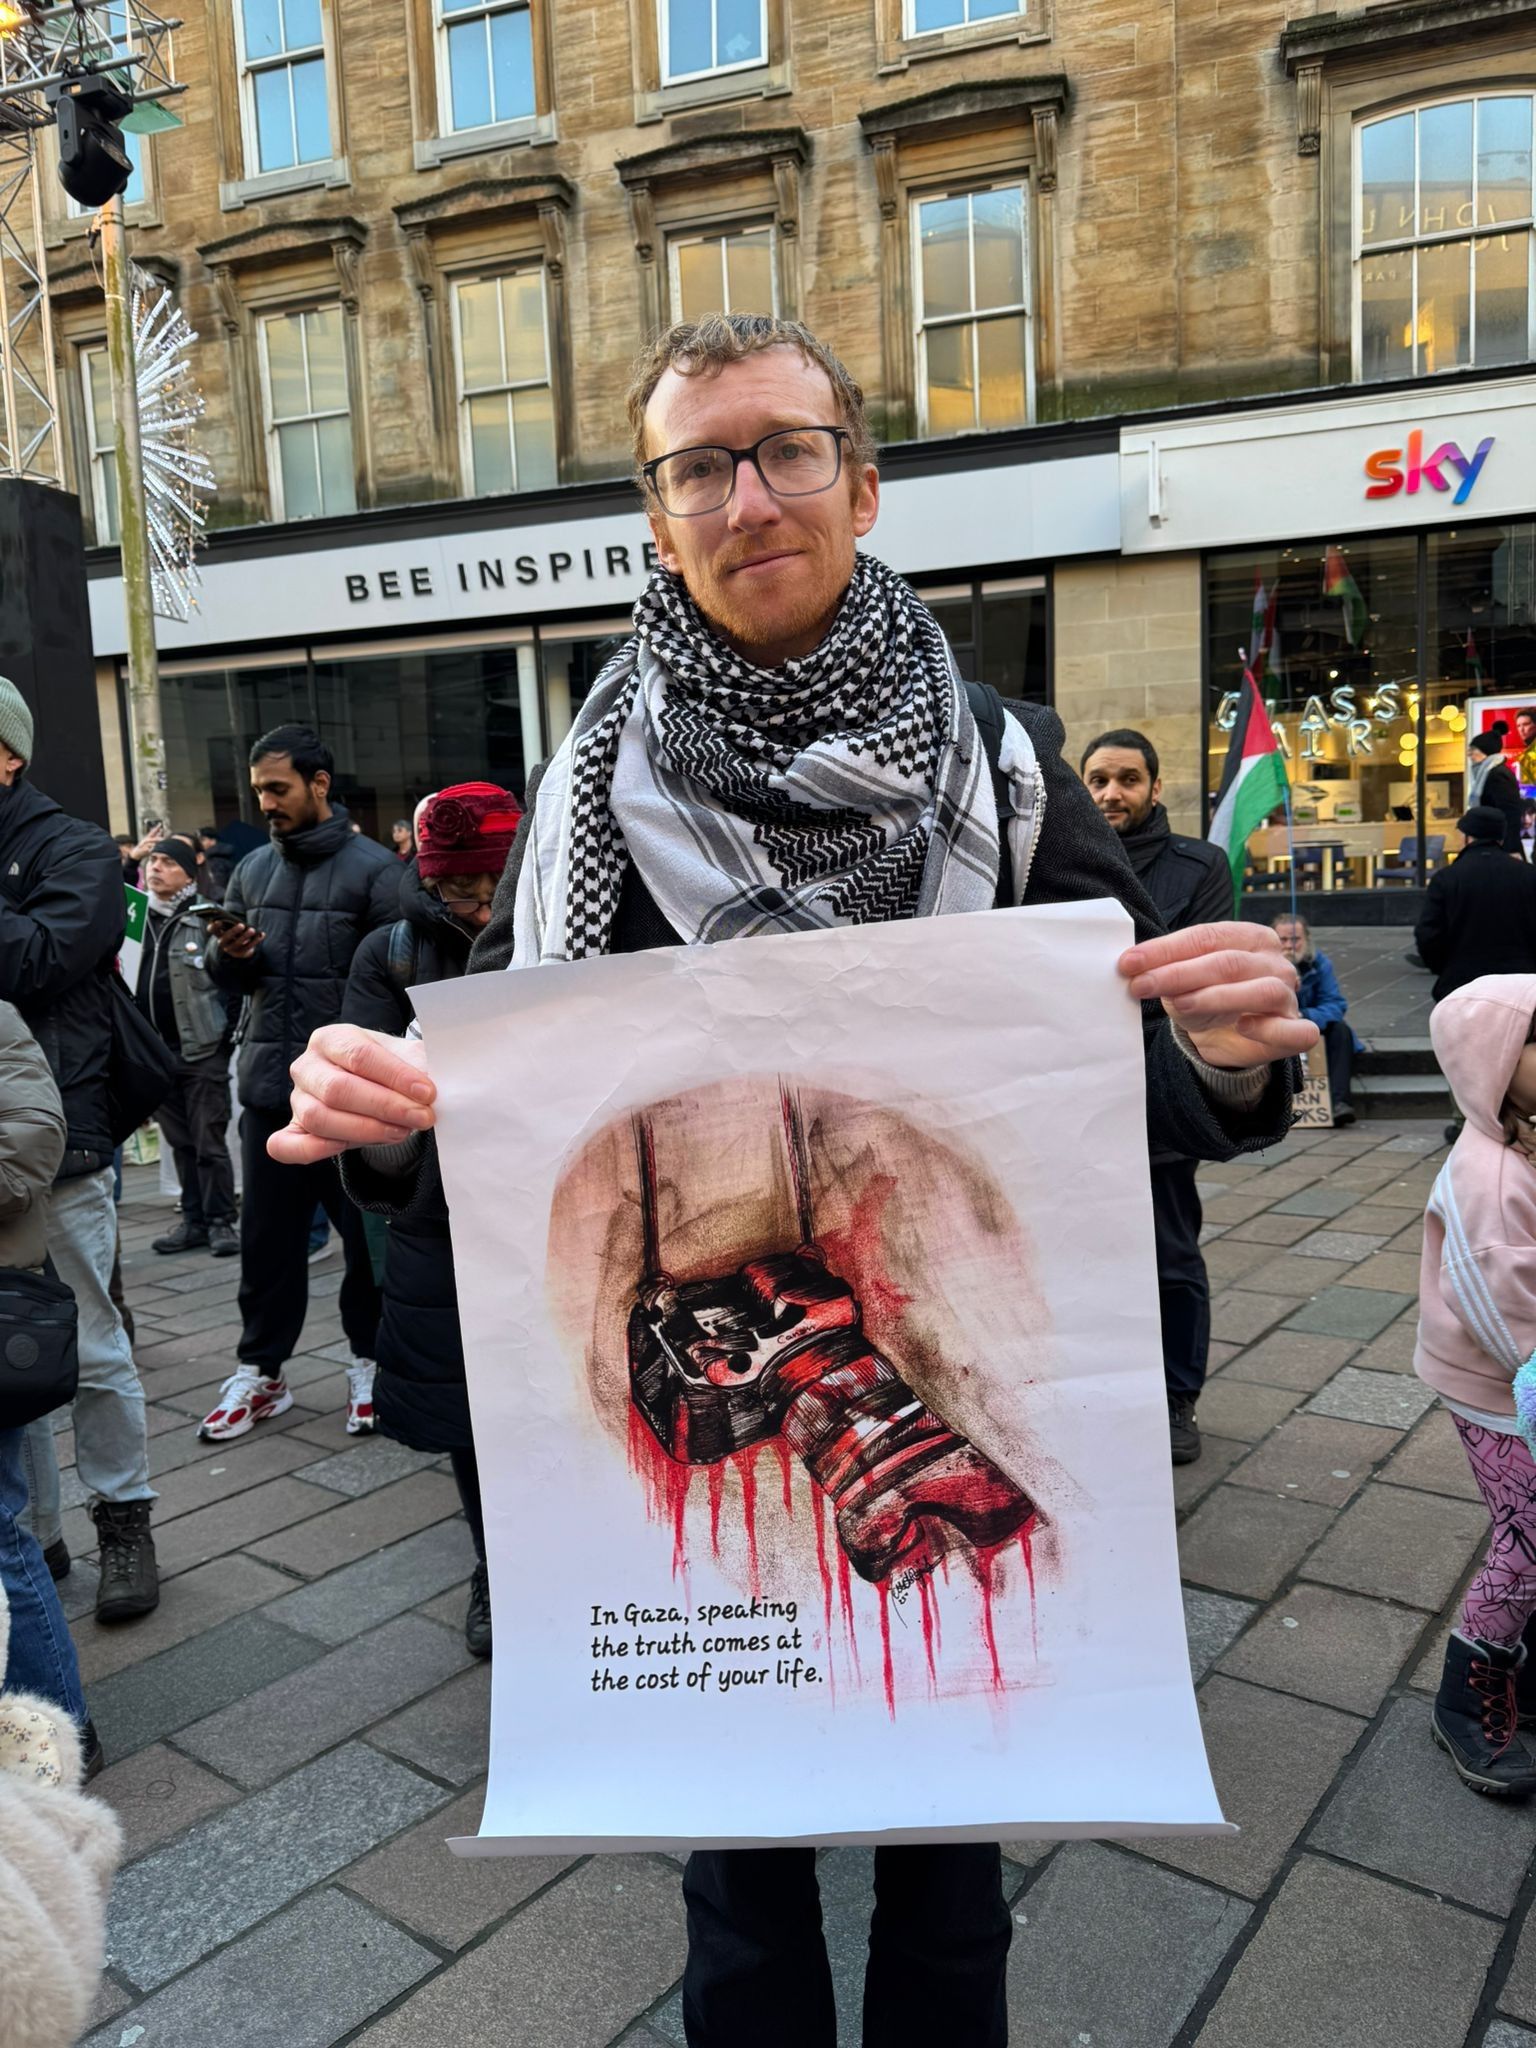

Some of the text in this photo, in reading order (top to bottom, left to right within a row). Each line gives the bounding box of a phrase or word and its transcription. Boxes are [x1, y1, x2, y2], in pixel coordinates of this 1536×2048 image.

[1365, 428, 1495, 505] sky
[345, 566, 434, 602] BEE
[590, 1595, 797, 1627] In Gaza, speaking
[591, 1627, 802, 1658] the truth comes at
[591, 1657, 822, 1692] the cost of your life.
